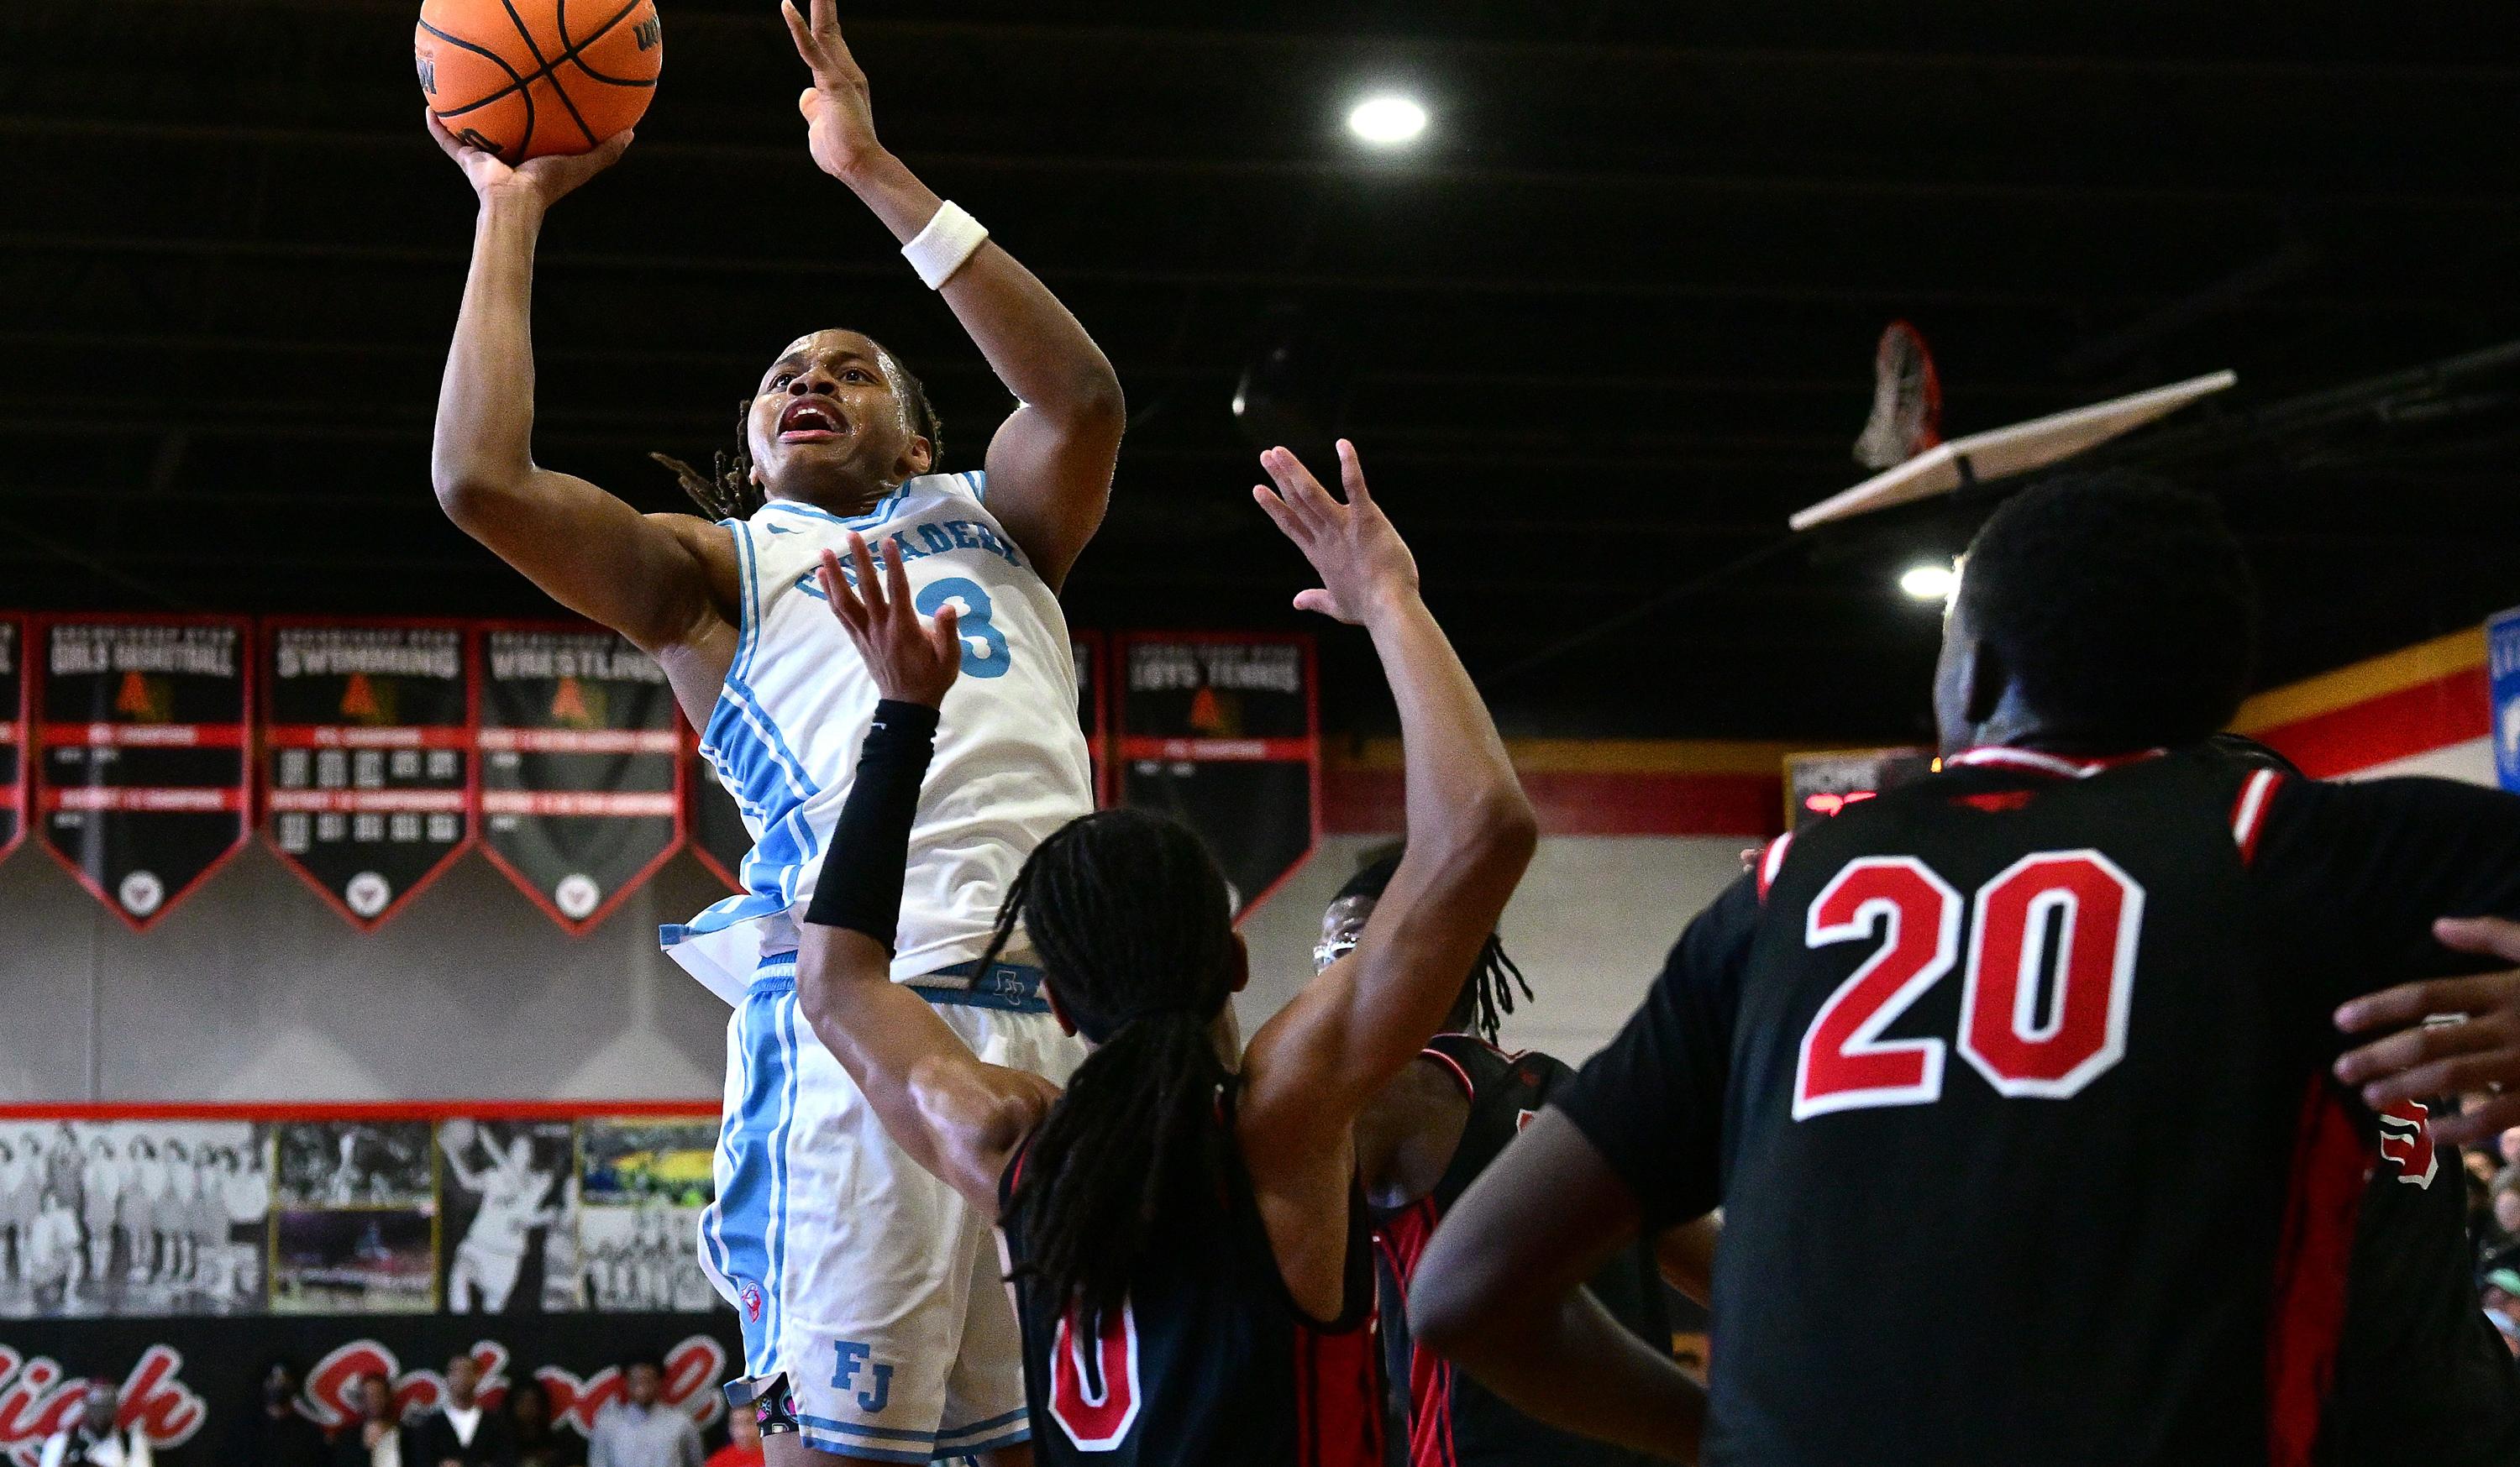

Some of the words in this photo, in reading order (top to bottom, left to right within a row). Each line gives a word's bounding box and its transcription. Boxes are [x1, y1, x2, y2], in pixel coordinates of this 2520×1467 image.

[915, 577, 1011, 678] 3
[1792, 848, 2147, 1122] 20
[0, 1344, 208, 1467] igh
[831, 1339, 895, 1413] FJ
